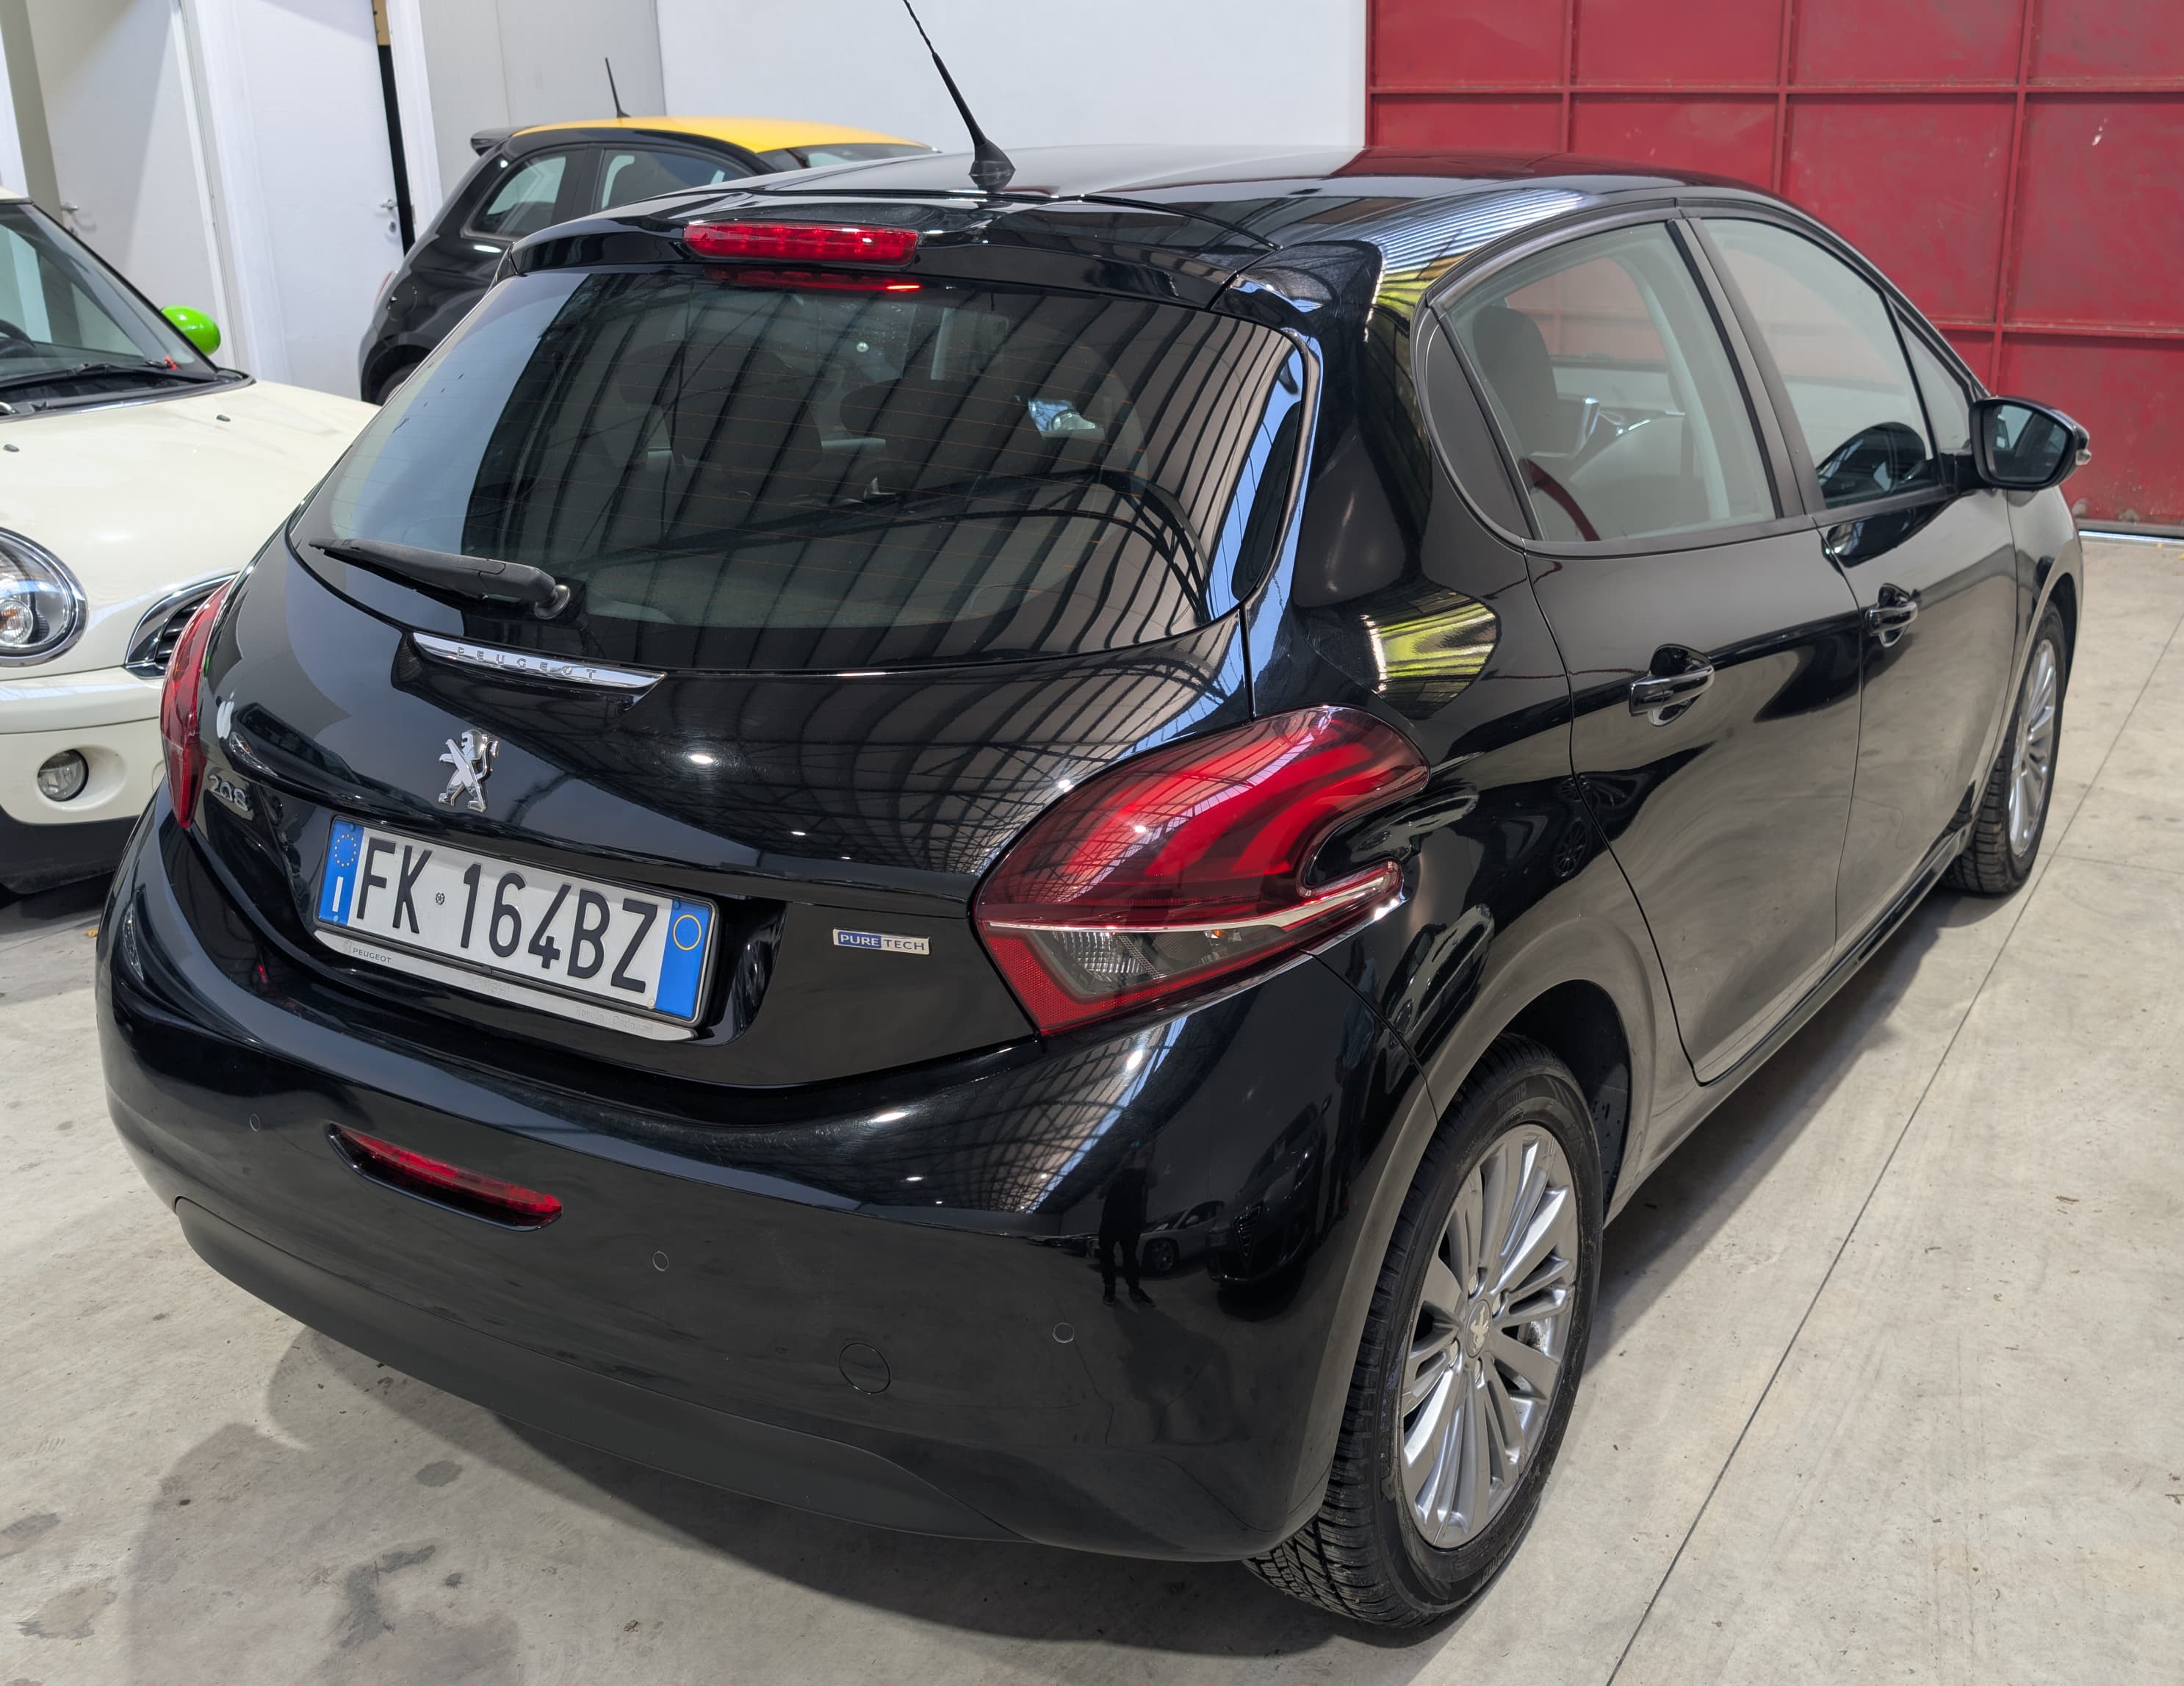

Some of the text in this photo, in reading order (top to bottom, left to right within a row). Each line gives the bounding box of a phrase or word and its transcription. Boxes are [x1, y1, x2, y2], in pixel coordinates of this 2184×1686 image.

[457, 646, 597, 680] PEUGEOT
[209, 774, 248, 812] 208
[356, 837, 658, 993] FK 164BZ
[353, 947, 392, 963] PEUGEOT
